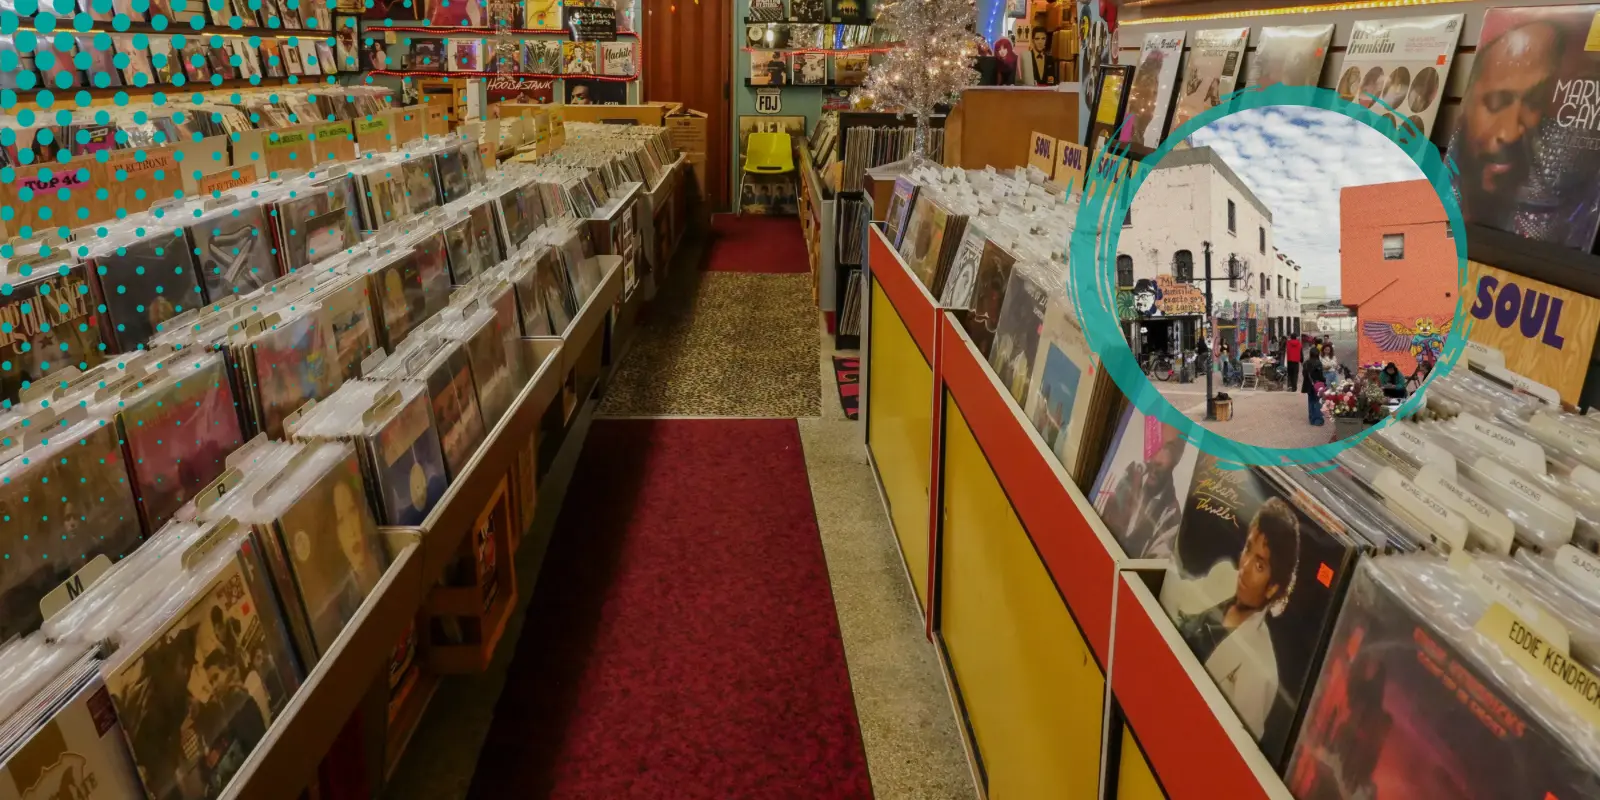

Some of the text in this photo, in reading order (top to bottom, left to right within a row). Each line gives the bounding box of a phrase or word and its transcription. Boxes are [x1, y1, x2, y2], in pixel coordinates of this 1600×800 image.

[1348, 37, 1396, 55] franklin
[759, 95, 778, 111] FDJ
[1556, 102, 1600, 131] GAY
[1034, 136, 1051, 160] SOUL
[1062, 145, 1083, 171] SOUL
[24, 177, 60, 191] TOP
[1470, 275, 1565, 351] SOUL
[1491, 433, 1516, 447] JACKSON
[1509, 478, 1542, 502] JACKSONS
[1196, 497, 1240, 528] Thriller
[1422, 498, 1448, 518] JACKSON
[1465, 497, 1491, 518] JACKSON
[65, 574, 85, 601] M
[1508, 620, 1543, 659] EDDIE
